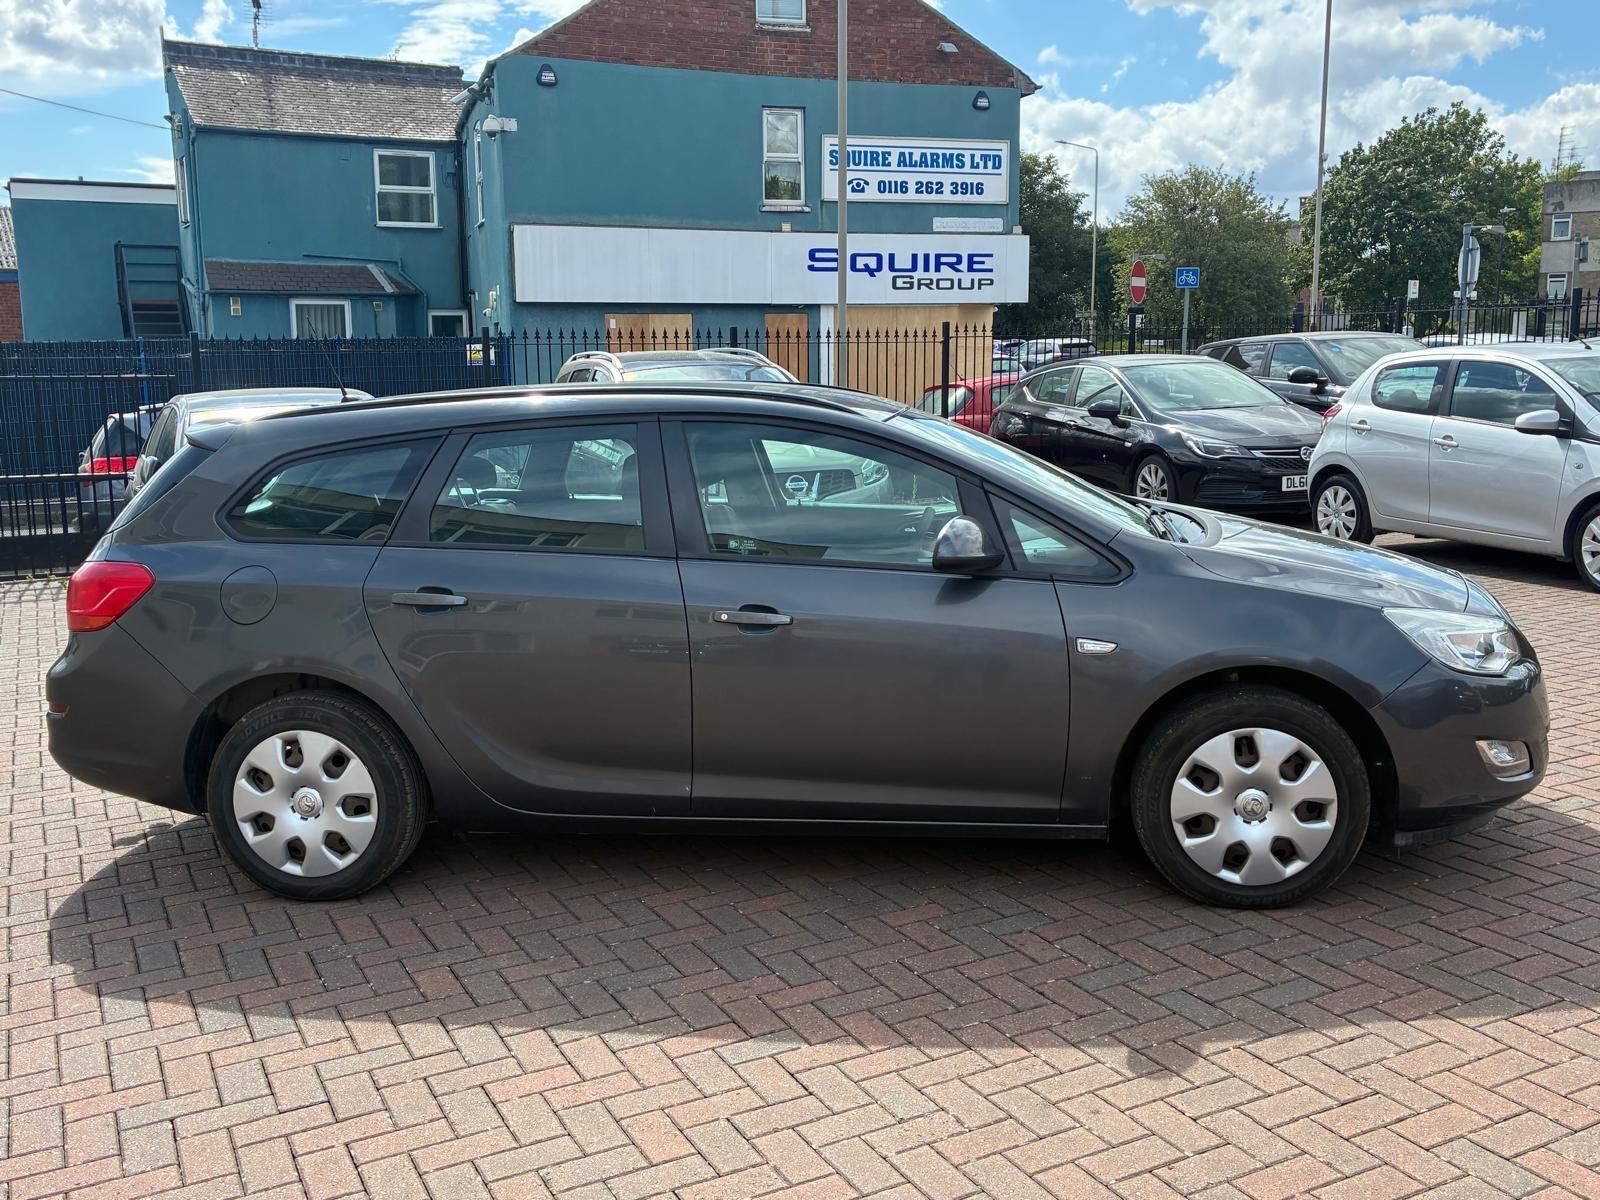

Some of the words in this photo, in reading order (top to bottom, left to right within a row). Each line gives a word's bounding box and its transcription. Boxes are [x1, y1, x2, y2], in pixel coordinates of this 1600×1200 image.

[829, 149, 892, 167] SUIRE
[897, 151, 966, 169] ALARMS
[970, 153, 1002, 169] LTD
[877, 180, 909, 194] 0116
[915, 181, 944, 194] 262
[950, 182, 985, 195] 3916
[807, 248, 994, 277] SQUIRE
